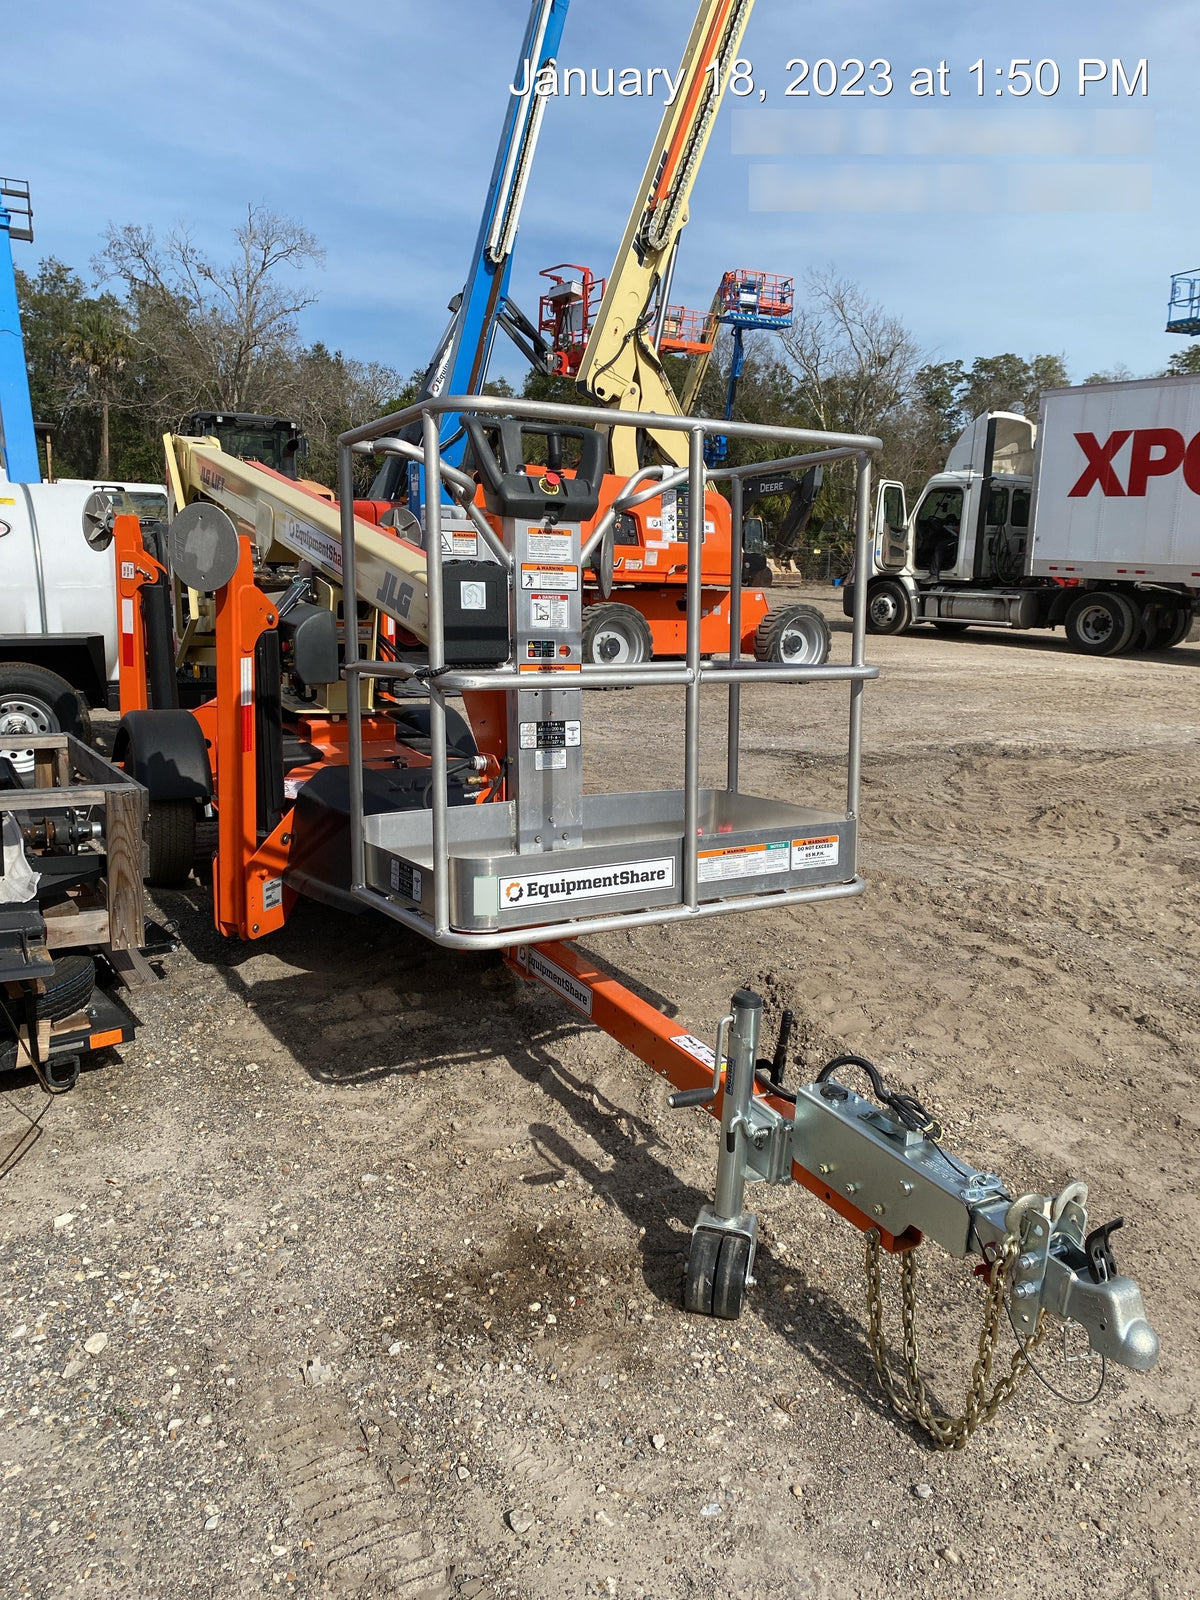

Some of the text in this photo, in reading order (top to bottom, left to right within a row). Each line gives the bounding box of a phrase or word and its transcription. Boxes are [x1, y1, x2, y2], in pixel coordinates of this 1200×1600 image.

[1067, 428, 1200, 497] XP
[760, 482, 783, 492] DEERE
[295, 523, 342, 567] EquipmentSha
[376, 571, 414, 619] JLG
[526, 869, 666, 900] EquipmentShare
